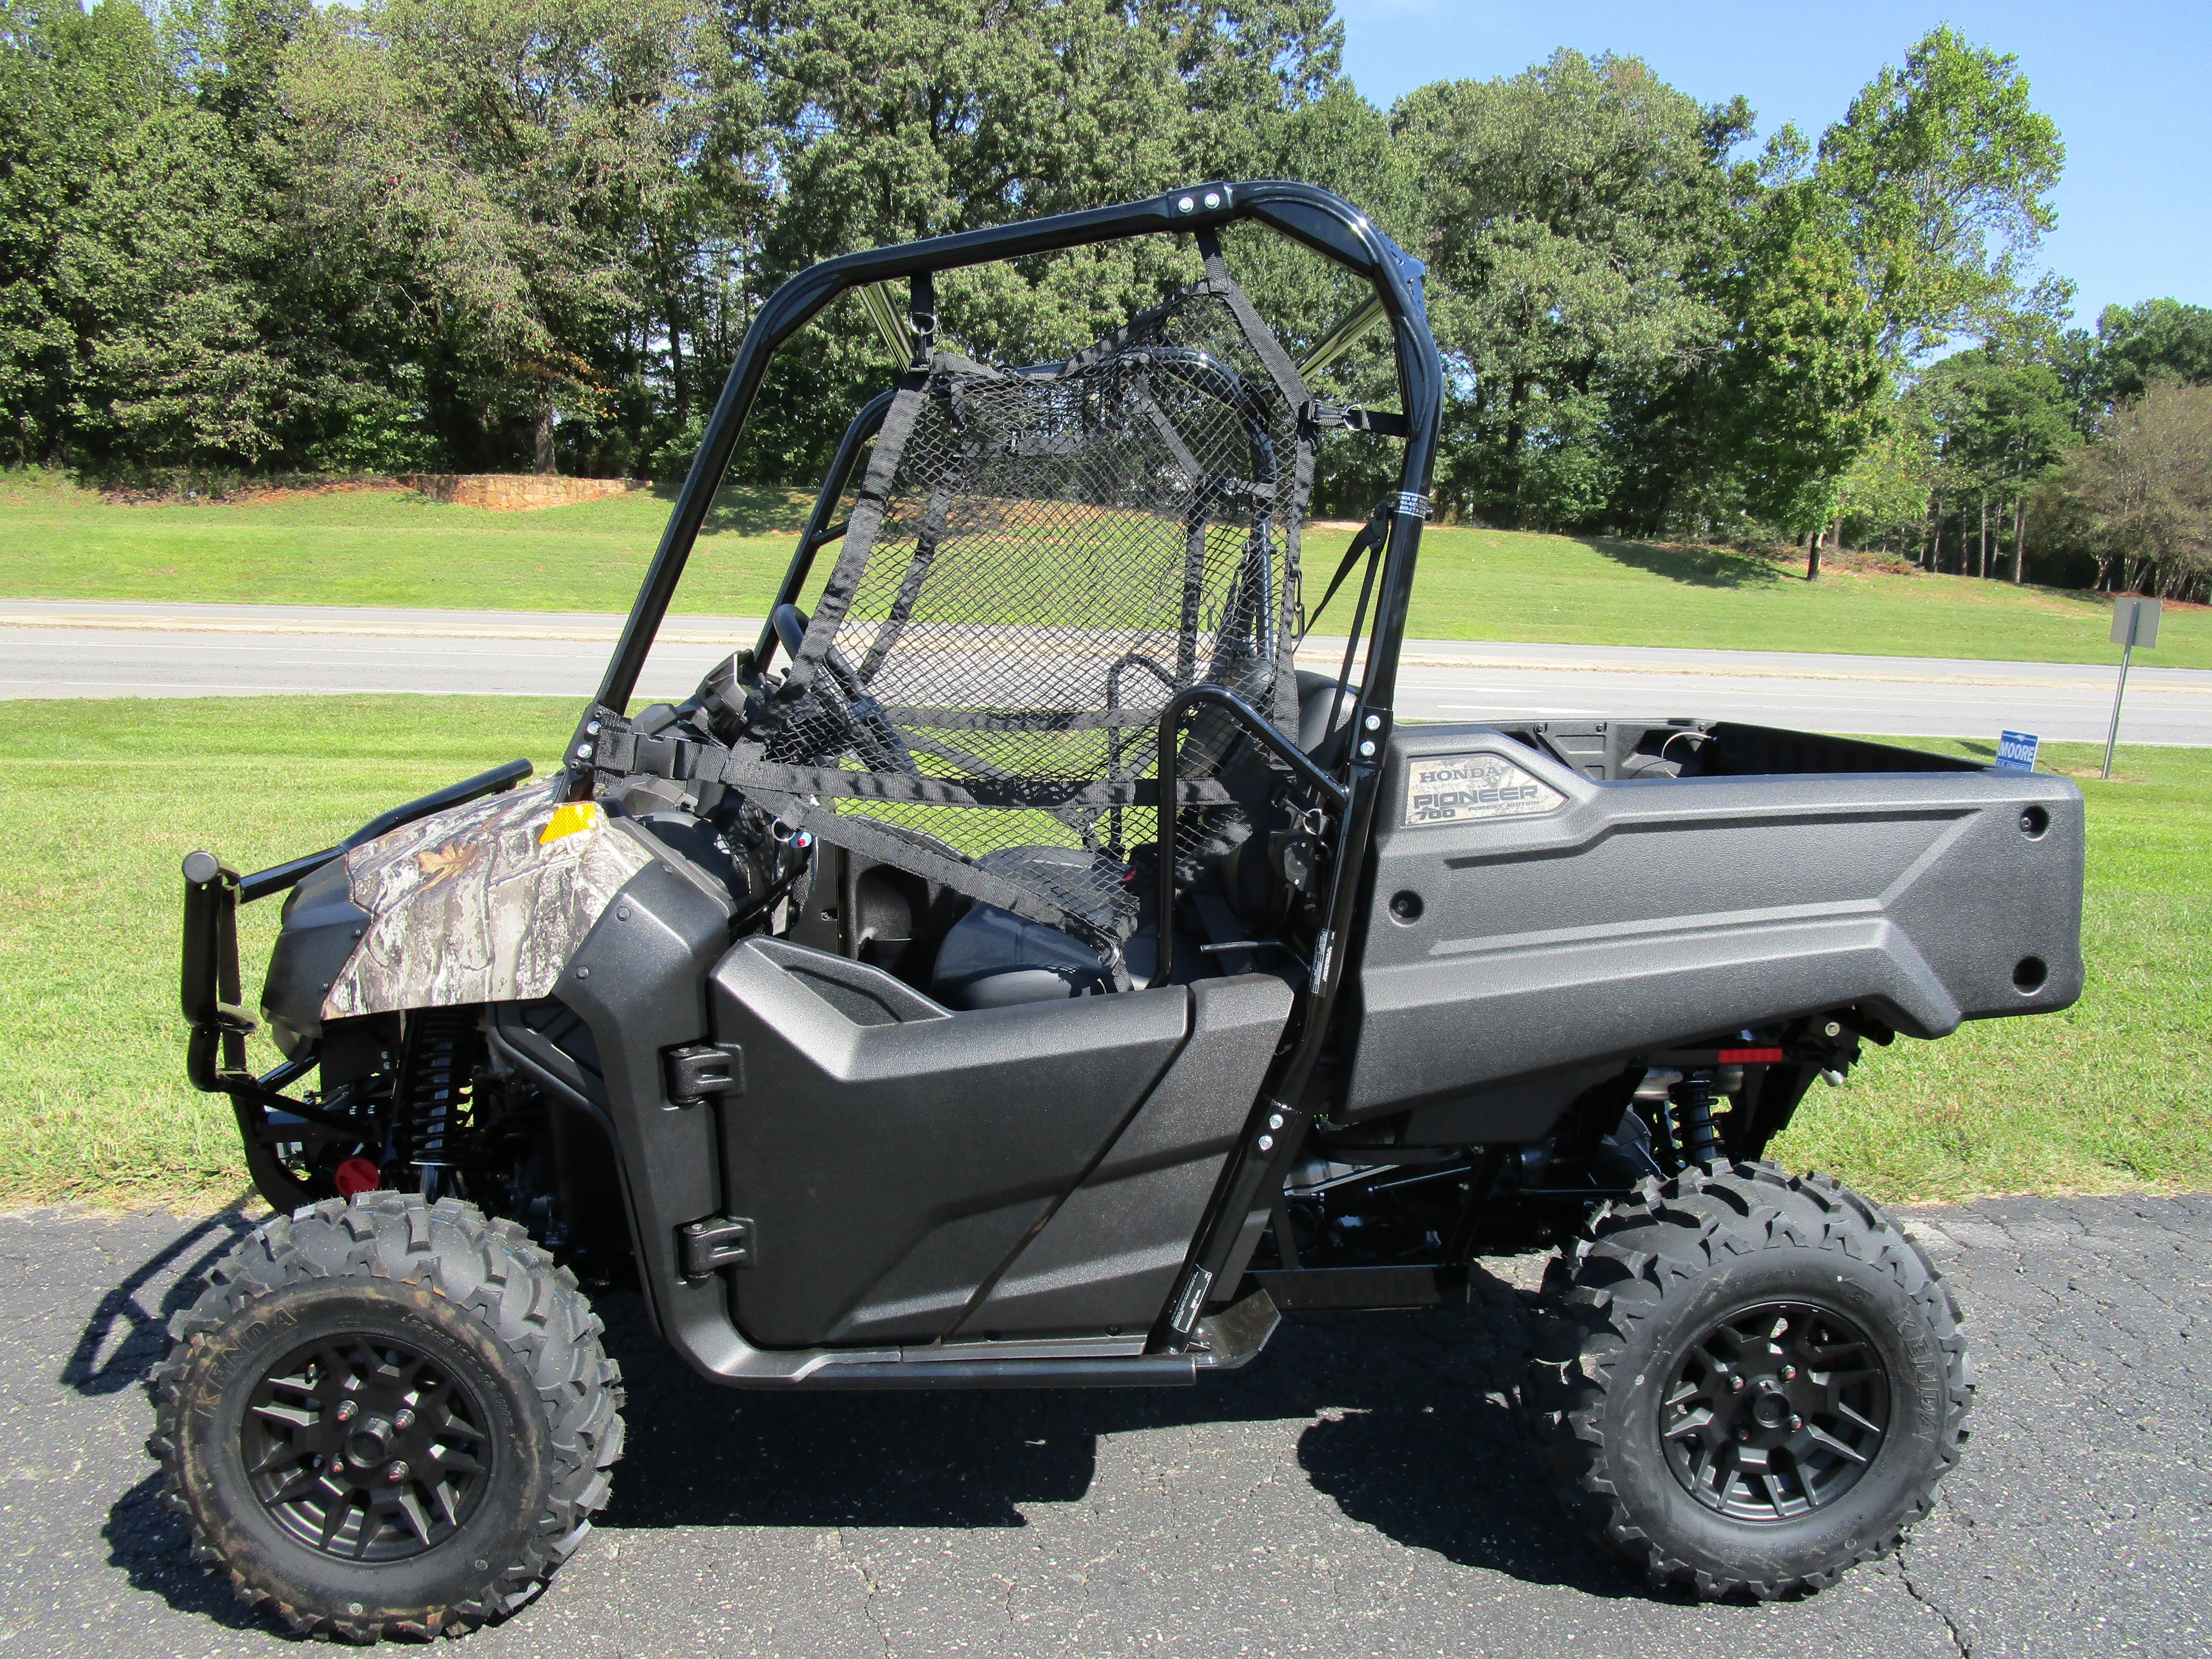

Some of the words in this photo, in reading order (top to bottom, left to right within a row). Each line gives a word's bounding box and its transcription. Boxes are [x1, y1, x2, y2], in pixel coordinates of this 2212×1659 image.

[1997, 740, 2036, 763] MOORE
[1419, 766, 1502, 783] HONDA
[1414, 785, 1538, 809] PIONEER
[1415, 808, 1456, 820] 700
[194, 1307, 298, 1419] KENDA
[1887, 1310, 1940, 1435] KENDA
